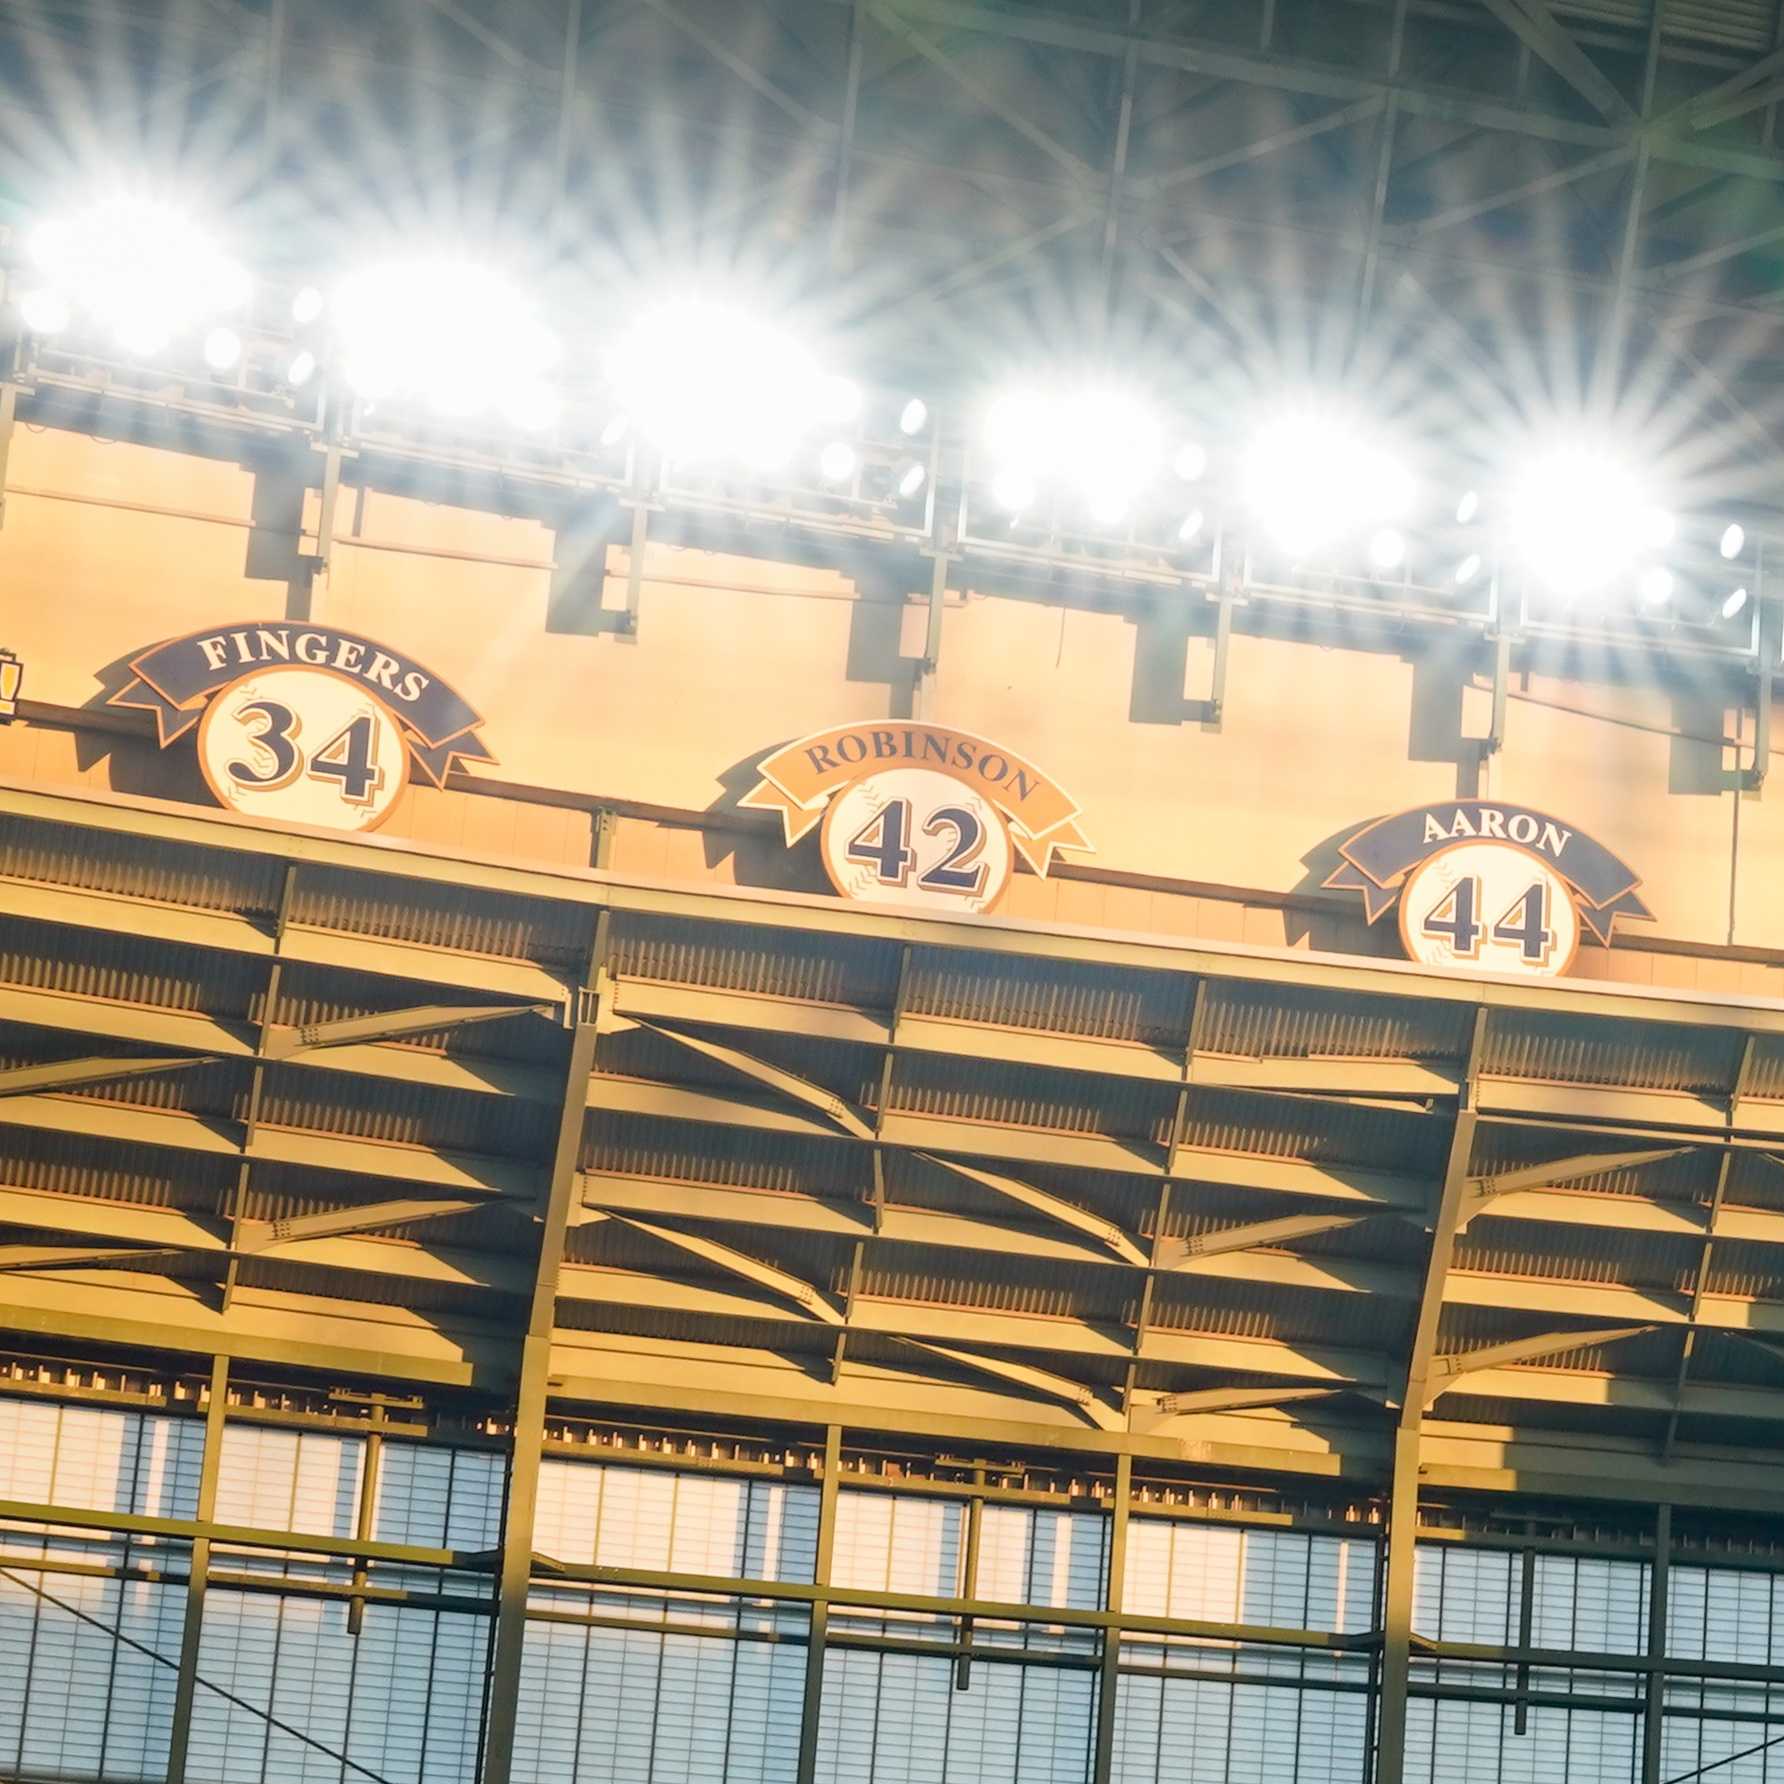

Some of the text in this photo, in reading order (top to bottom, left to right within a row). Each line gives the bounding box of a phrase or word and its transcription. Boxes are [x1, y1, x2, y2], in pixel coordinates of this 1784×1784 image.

[197, 629, 429, 703] FINGERS
[225, 700, 382, 803] 34
[804, 730, 1042, 800] ROBINSON
[846, 797, 986, 893] 42
[1422, 806, 1572, 857] AARON
[1422, 873, 1555, 964] 44
